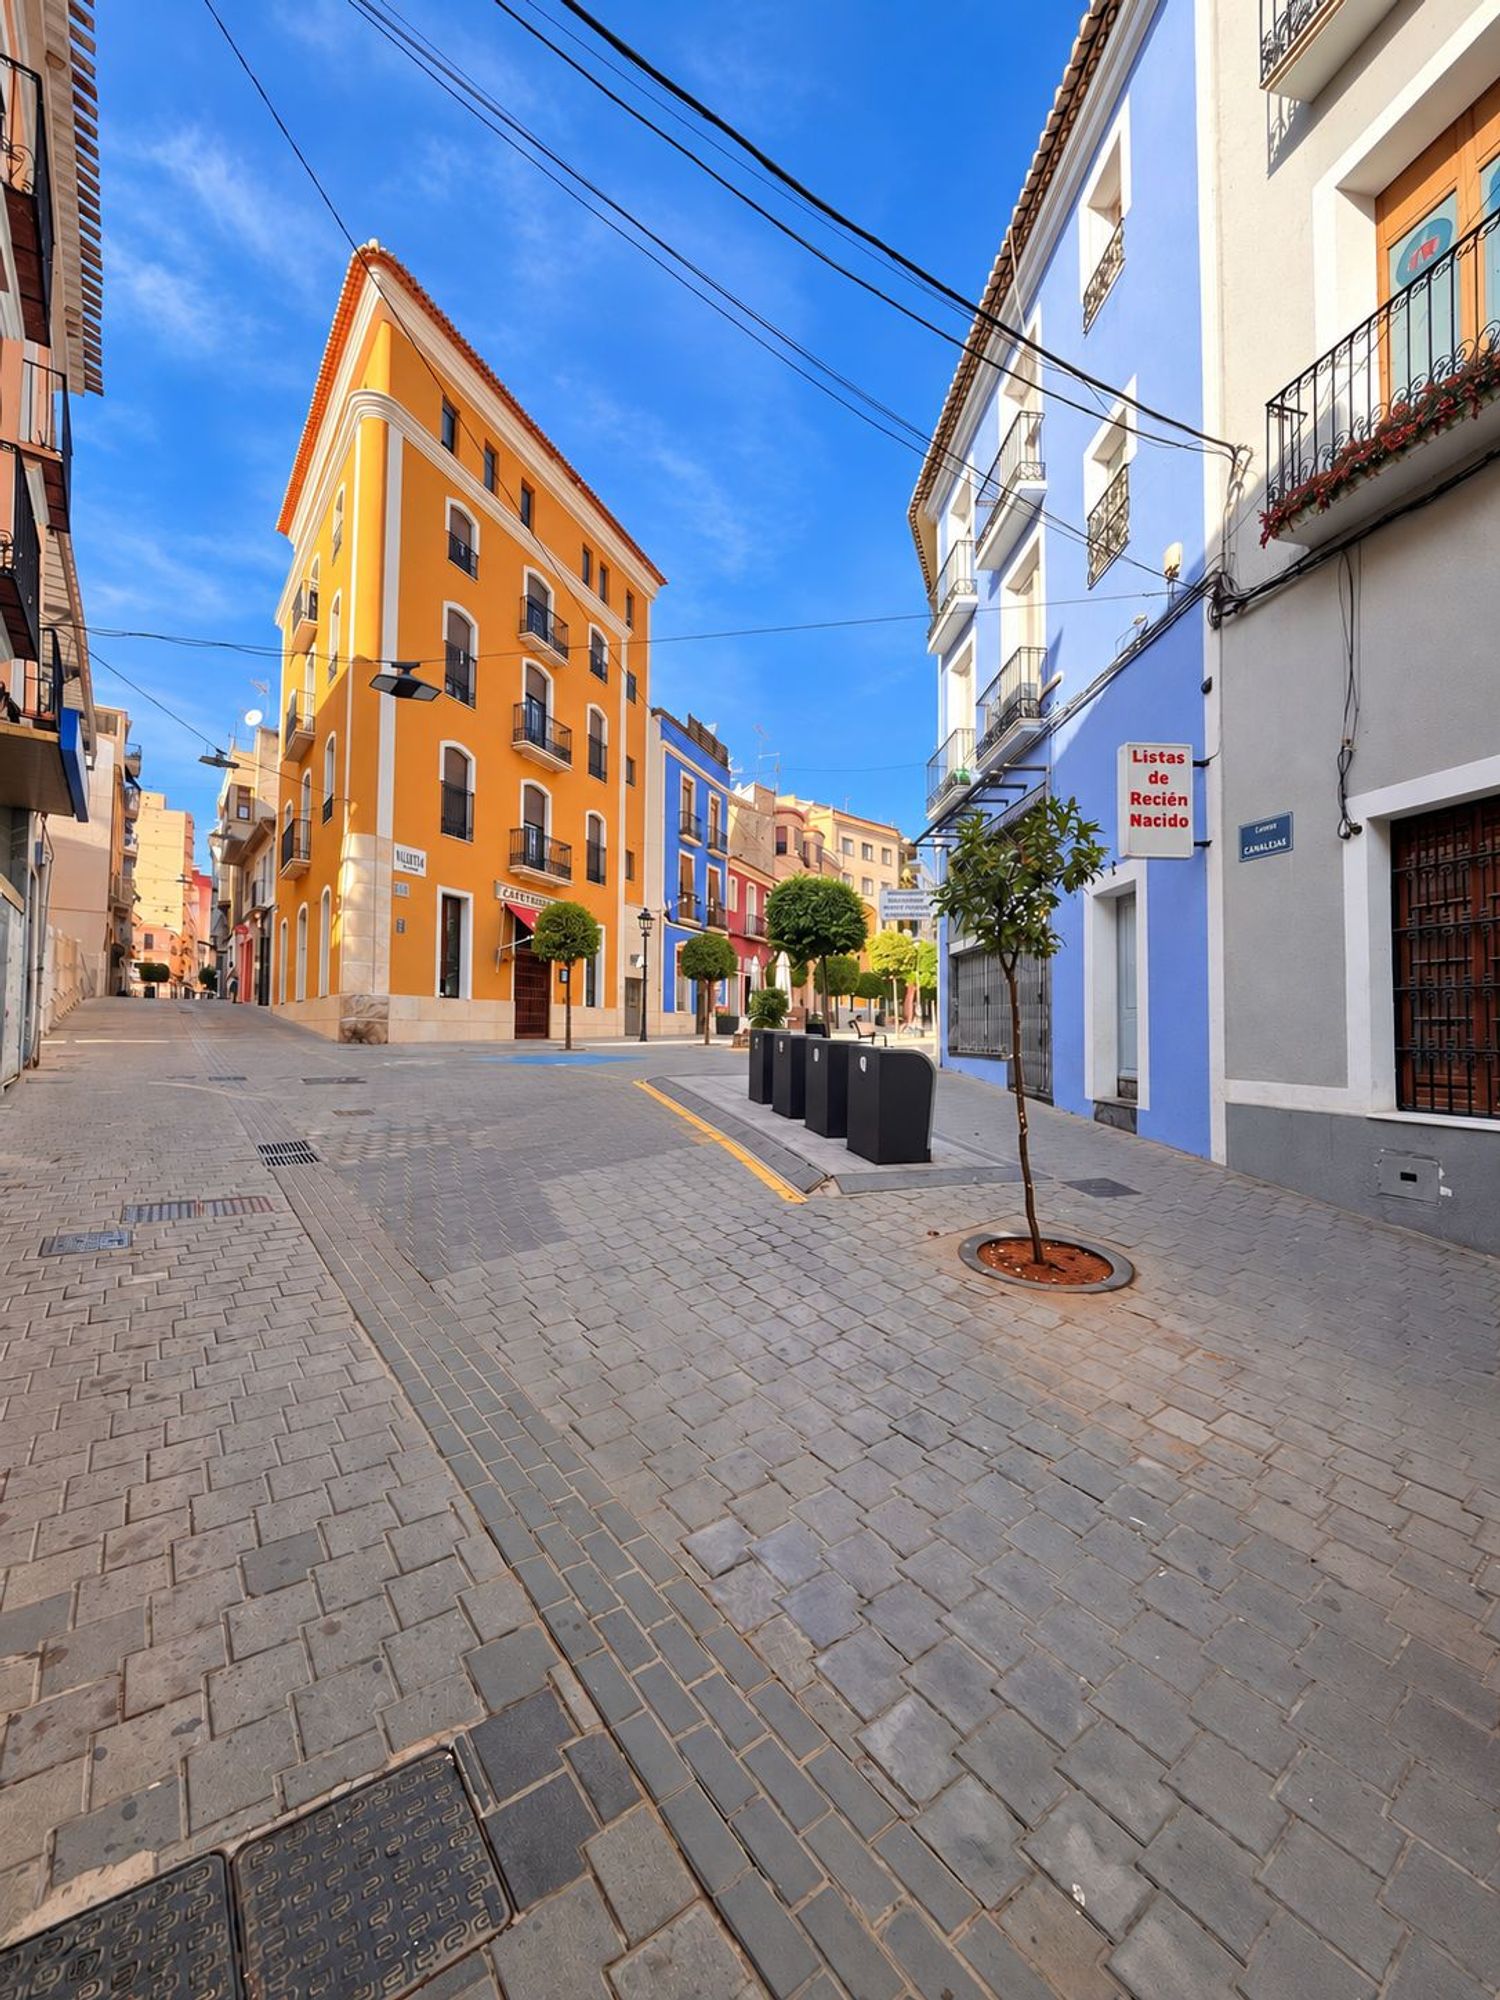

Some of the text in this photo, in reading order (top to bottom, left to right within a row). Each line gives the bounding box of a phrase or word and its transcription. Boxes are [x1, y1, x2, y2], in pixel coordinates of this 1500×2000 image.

[1132, 749, 1185, 764] Listas
[1148, 770, 1169, 785] de
[1130, 791, 1188, 806] Recién
[1130, 813, 1189, 828] Nacido
[1244, 837, 1286, 855] CANALEJAS
